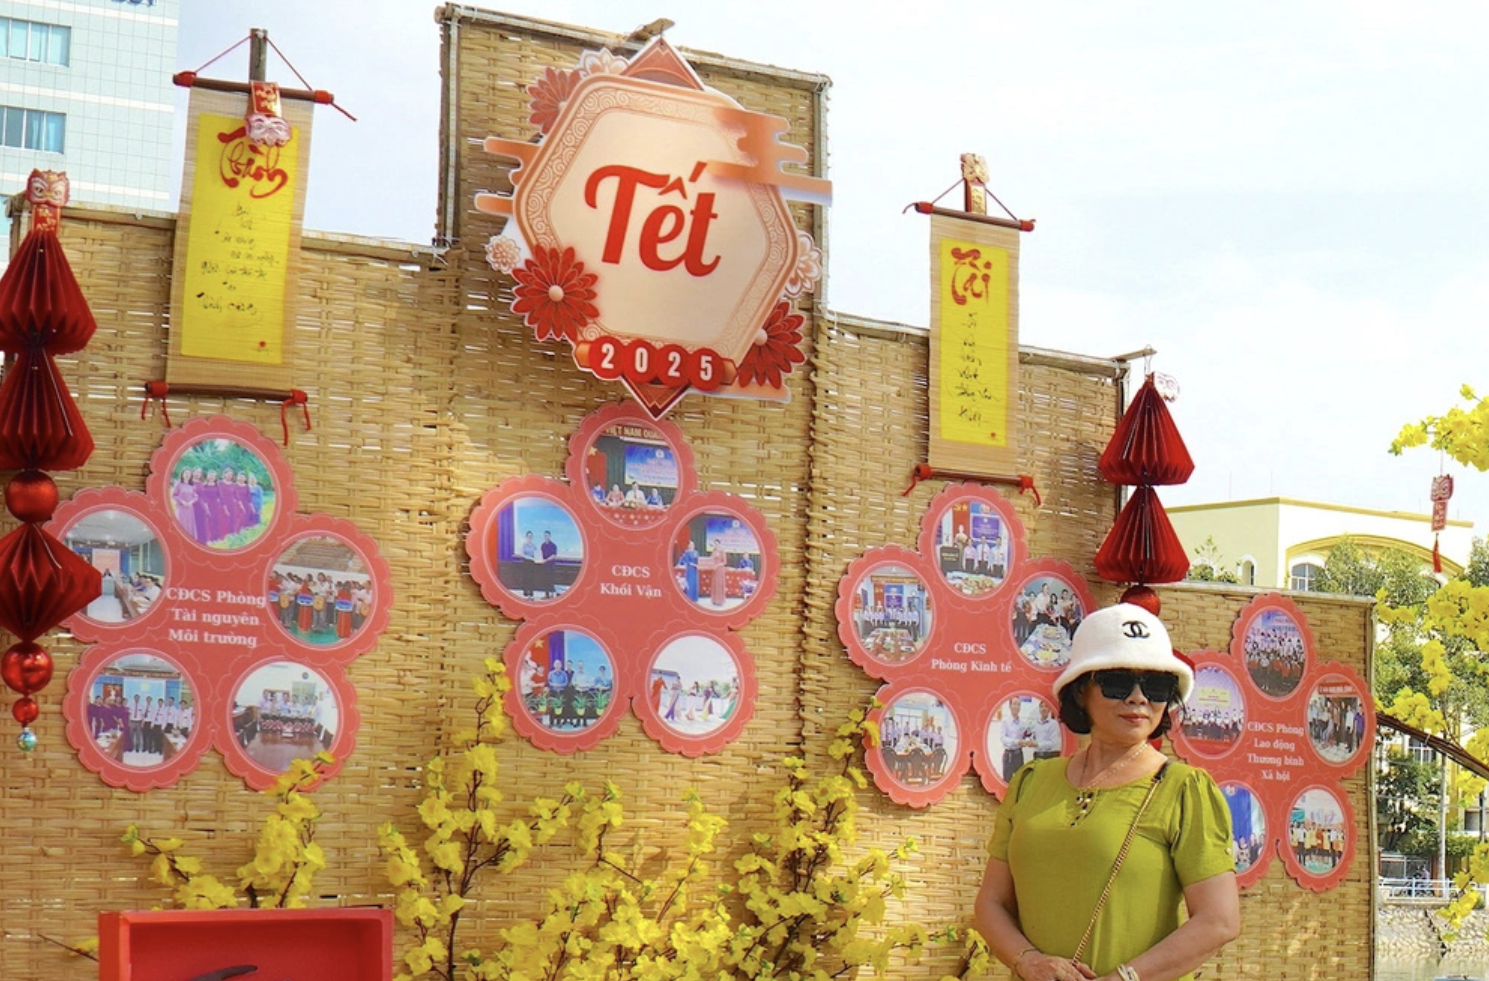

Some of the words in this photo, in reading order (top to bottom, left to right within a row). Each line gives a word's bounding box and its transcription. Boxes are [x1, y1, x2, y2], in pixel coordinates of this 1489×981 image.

[584, 161, 722, 277] Tết
[600, 343, 713, 381] 2025
[611, 564, 651, 578] CĐCS
[166, 586, 211, 602] CĐCS
[216, 589, 267, 608] Phòng
[600, 582, 633, 596] Khối
[636, 584, 663, 599] Vận
[171, 607, 197, 622] Tài
[201, 611, 260, 627] nguyên
[168, 628, 199, 642] Môi
[203, 631, 258, 648] trường
[954, 642, 987, 655] CĐCS
[931, 658, 968, 673] Phòng
[970, 660, 998, 672] Kinh
[1000, 660, 1013, 673] tế
[1247, 721, 1274, 733] CĐCS
[1276, 723, 1305, 737] Phòng
[1254, 737, 1271, 748] Lao
[1273, 738, 1296, 752] động
[1284, 755, 1305, 766] binh
[1276, 770, 1291, 782] hội
